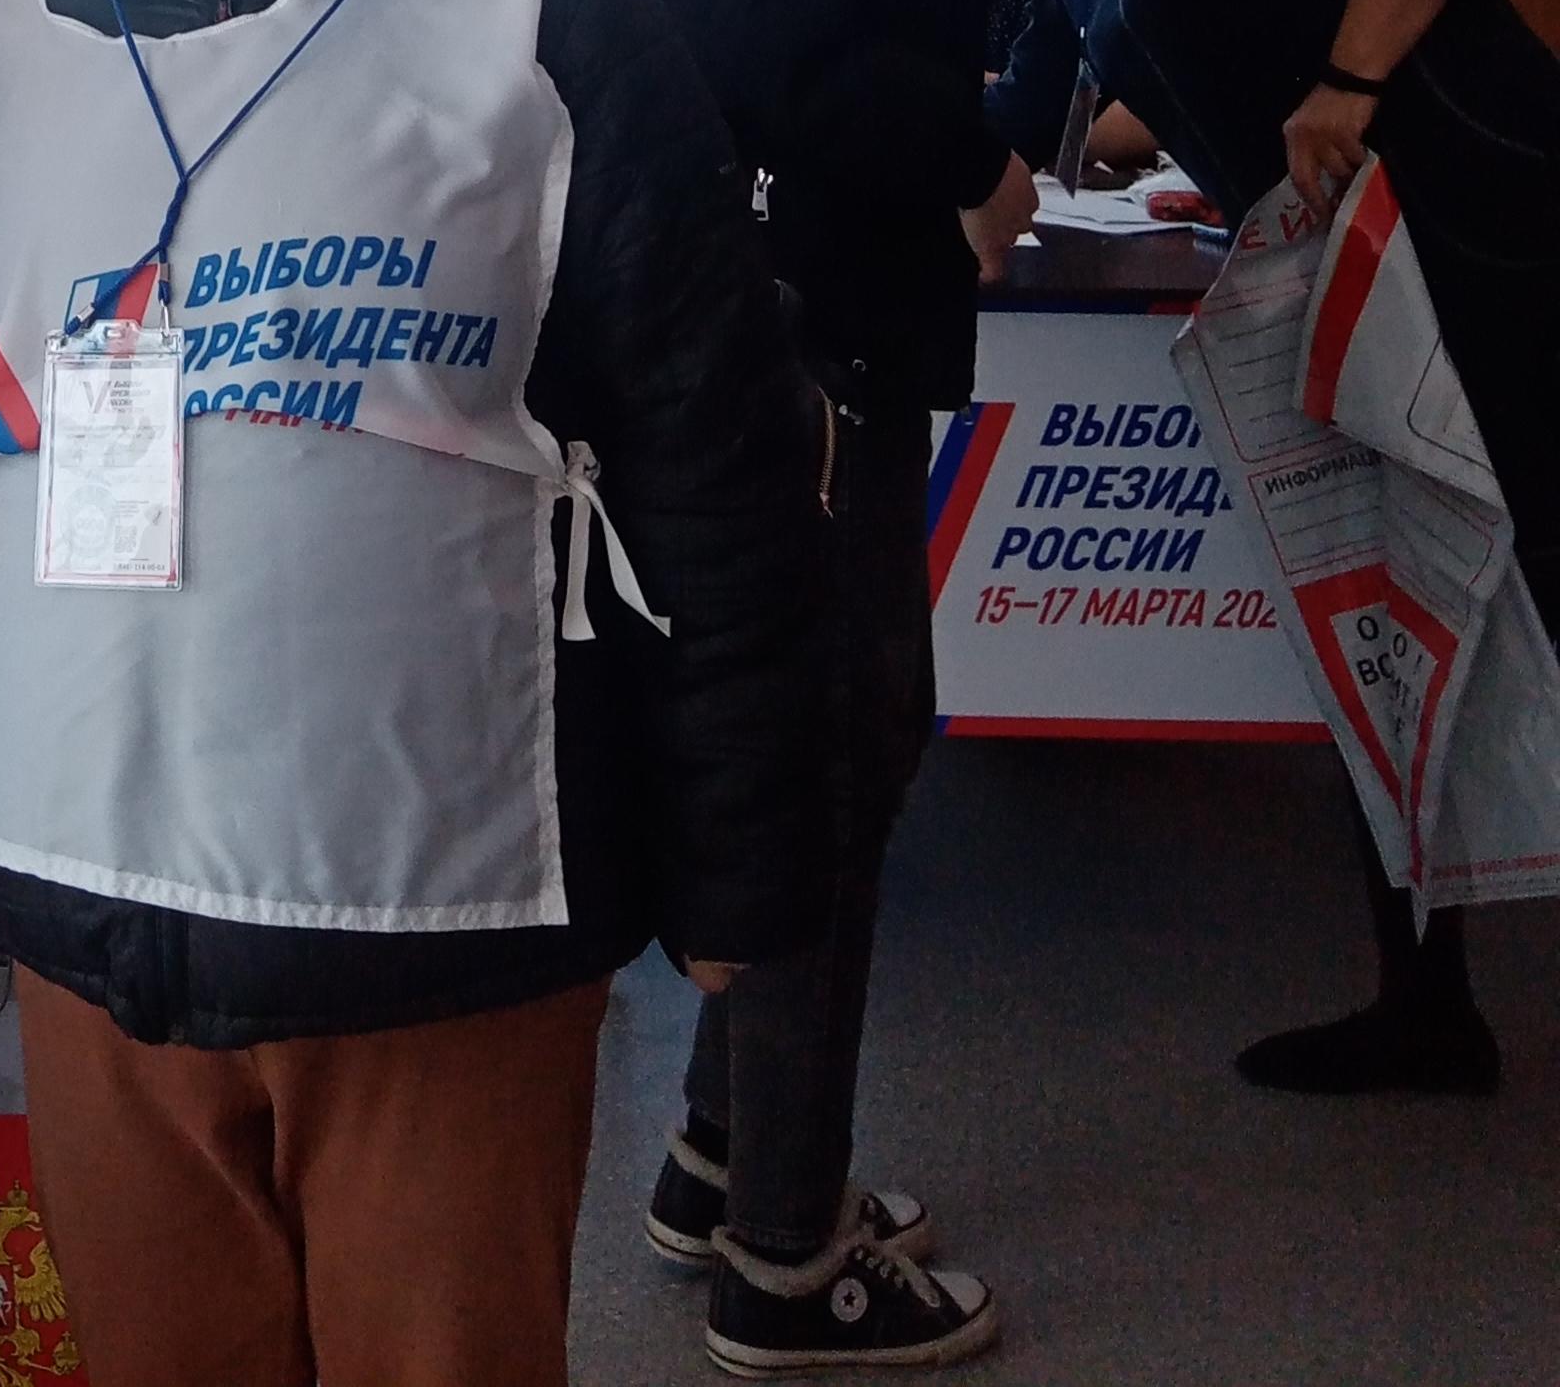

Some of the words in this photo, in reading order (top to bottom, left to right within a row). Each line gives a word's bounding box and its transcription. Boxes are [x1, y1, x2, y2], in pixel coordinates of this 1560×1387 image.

[184, 235, 438, 309] ВЫБОРЫ
[991, 526, 1205, 572] РОССИИ
[1080, 588, 1207, 627] МАРТА
